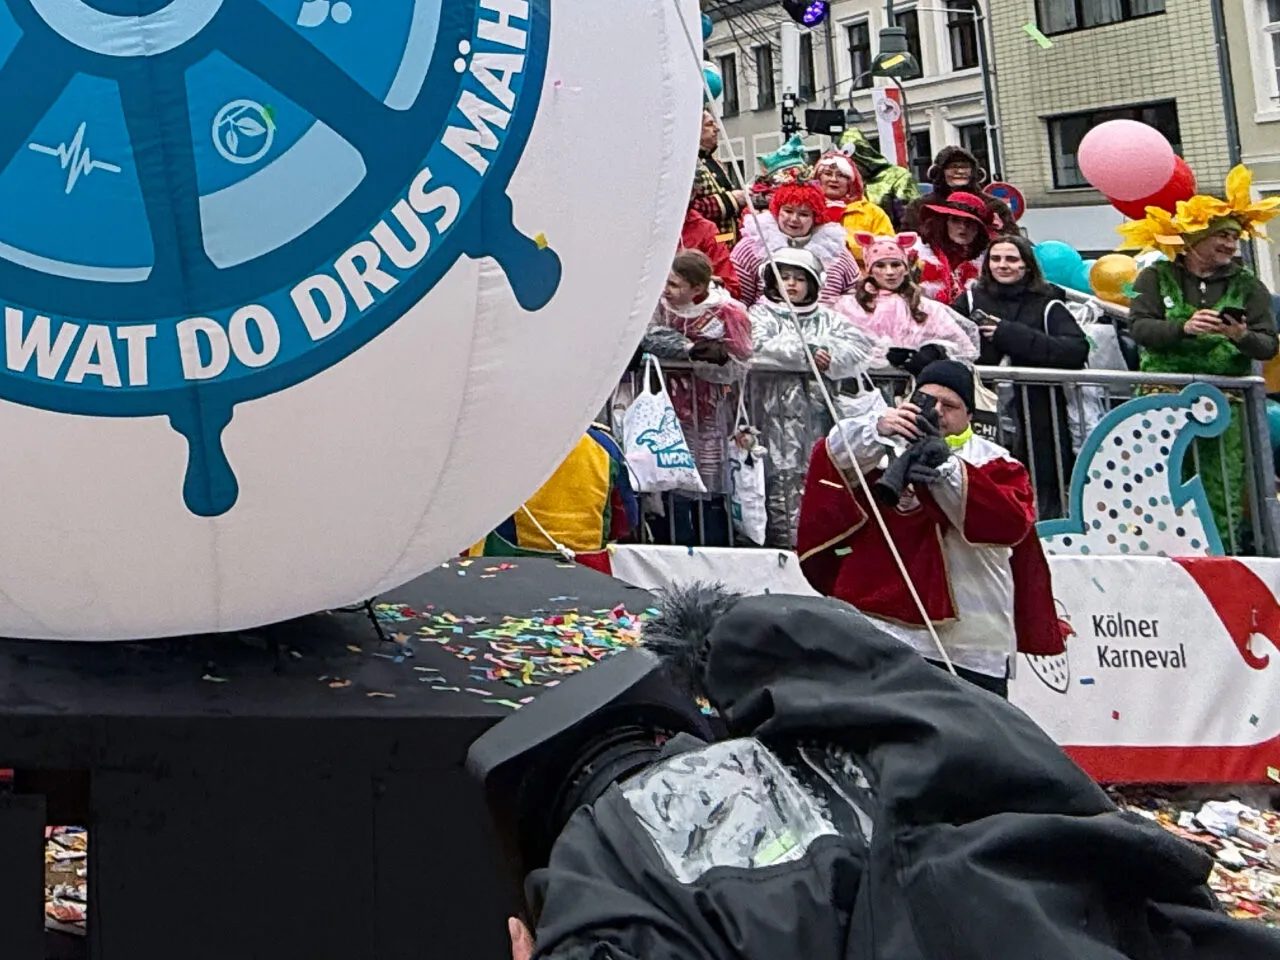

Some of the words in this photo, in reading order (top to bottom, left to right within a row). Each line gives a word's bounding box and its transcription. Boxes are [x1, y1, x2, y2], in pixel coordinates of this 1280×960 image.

[4, 306, 157, 387] WAT
[175, 304, 282, 381] DO
[290, 167, 461, 342] DRUS
[659, 452, 691, 467] WDR
[1092, 611, 1159, 638] Kölner
[1097, 642, 1187, 668] Karneval
